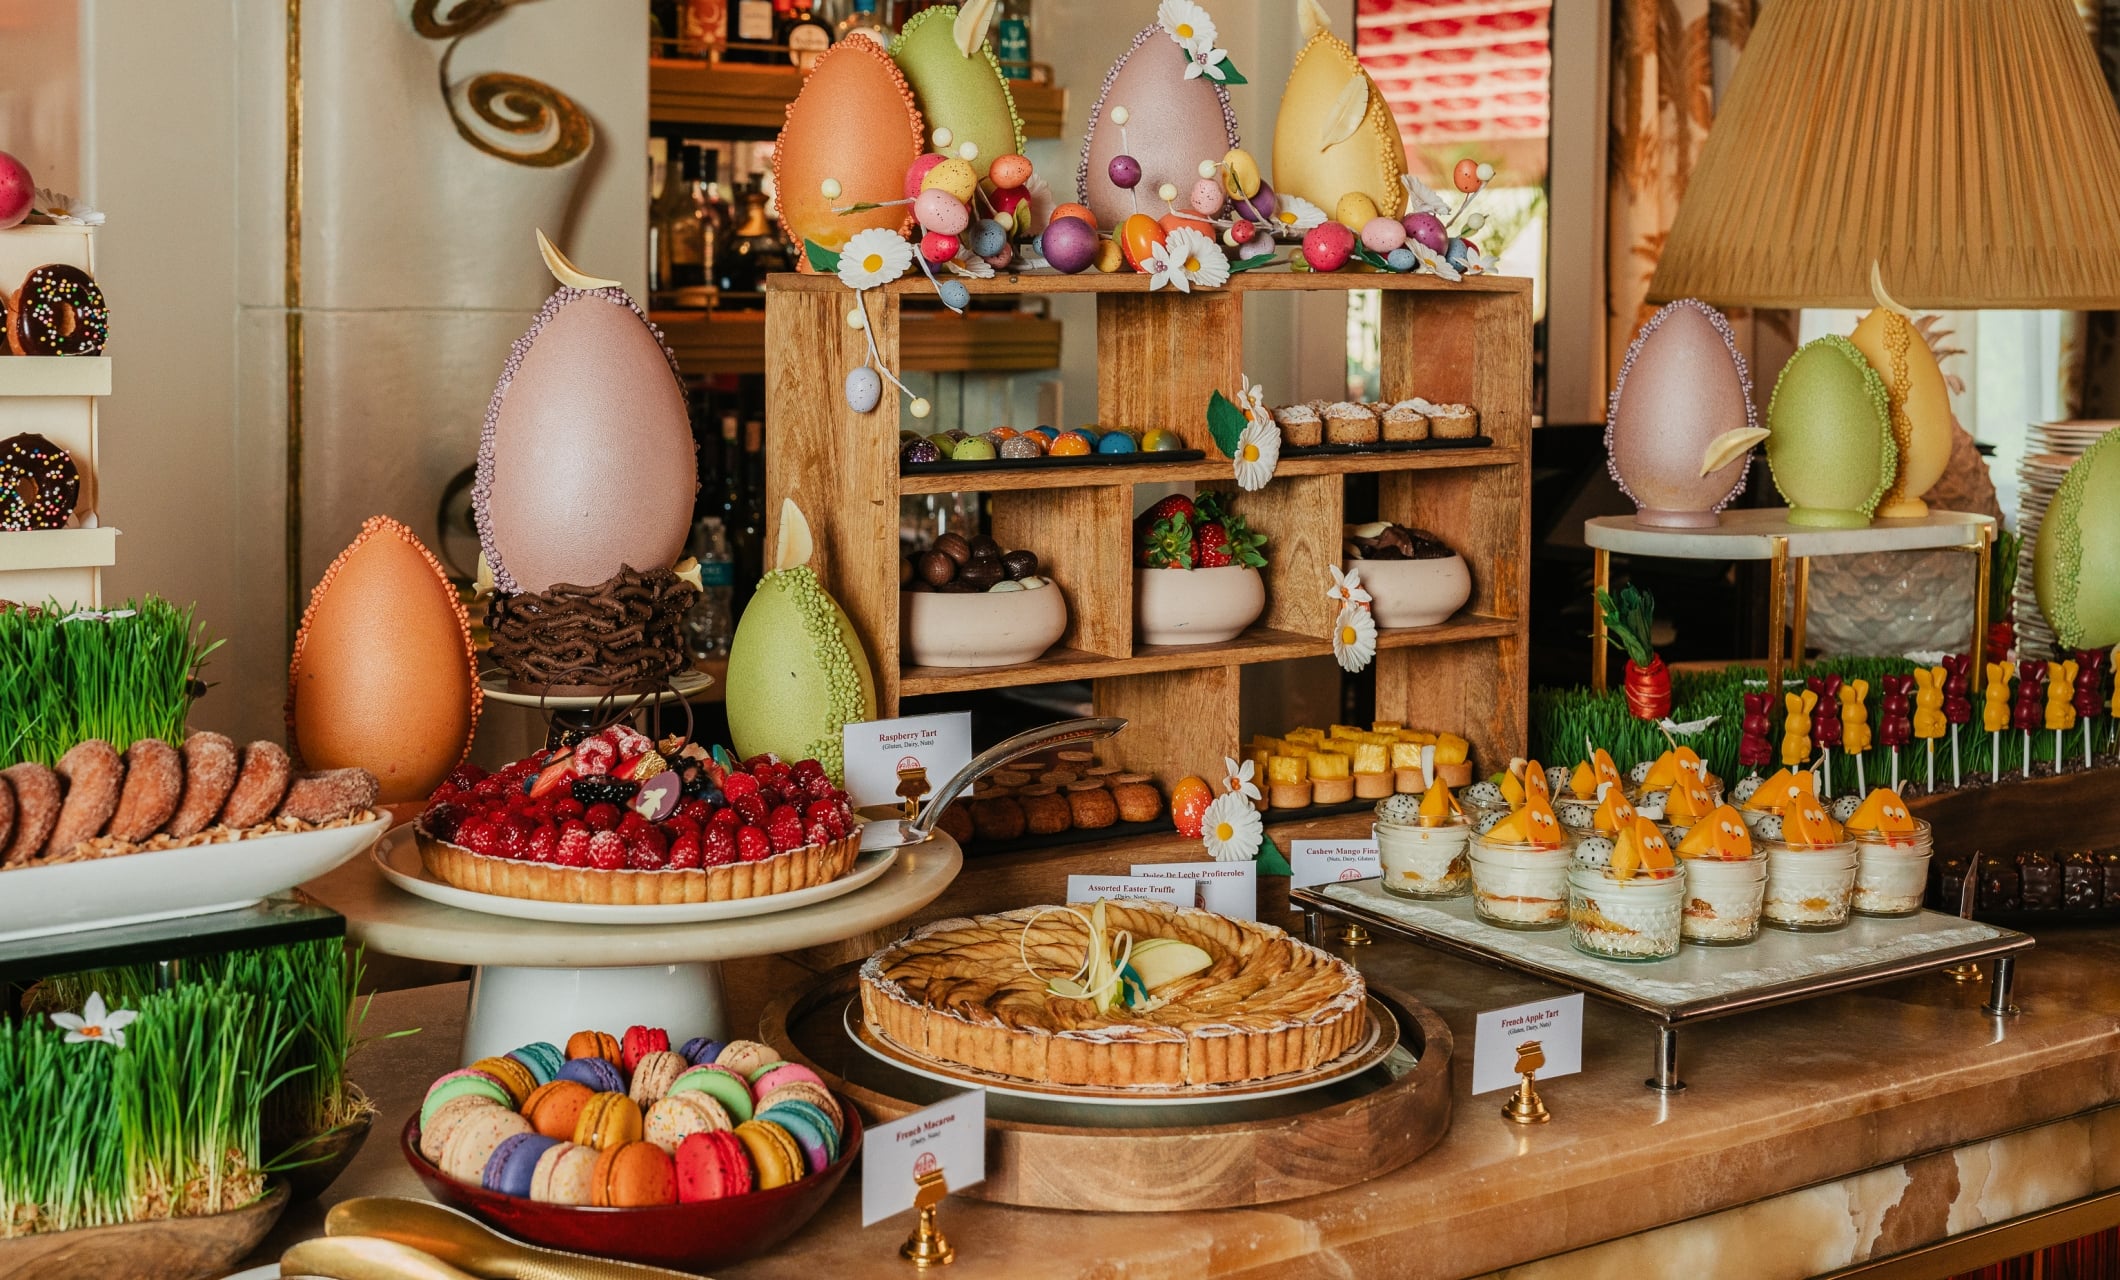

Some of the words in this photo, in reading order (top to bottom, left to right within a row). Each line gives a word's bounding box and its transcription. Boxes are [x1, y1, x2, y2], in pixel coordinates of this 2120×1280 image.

[879, 732, 919, 742] Raspberry
[920, 729, 937, 738] Tart
[882, 743, 903, 751] (Gluten,
[1306, 847, 1333, 855] Cashew
[1336, 847, 1360, 855] Mango
[1178, 871, 1201, 880] Leche
[1202, 869, 1245, 878] Profiteroles
[1088, 884, 1121, 893] Assorted
[1123, 884, 1148, 893] Easter
[1149, 885, 1176, 894] Truffle
[1501, 1016, 1524, 1028] French
[1525, 1011, 1544, 1024] Apple
[1545, 1009, 1559, 1019] Tart
[896, 1125, 921, 1142] French
[923, 1114, 955, 1131] Macaron
